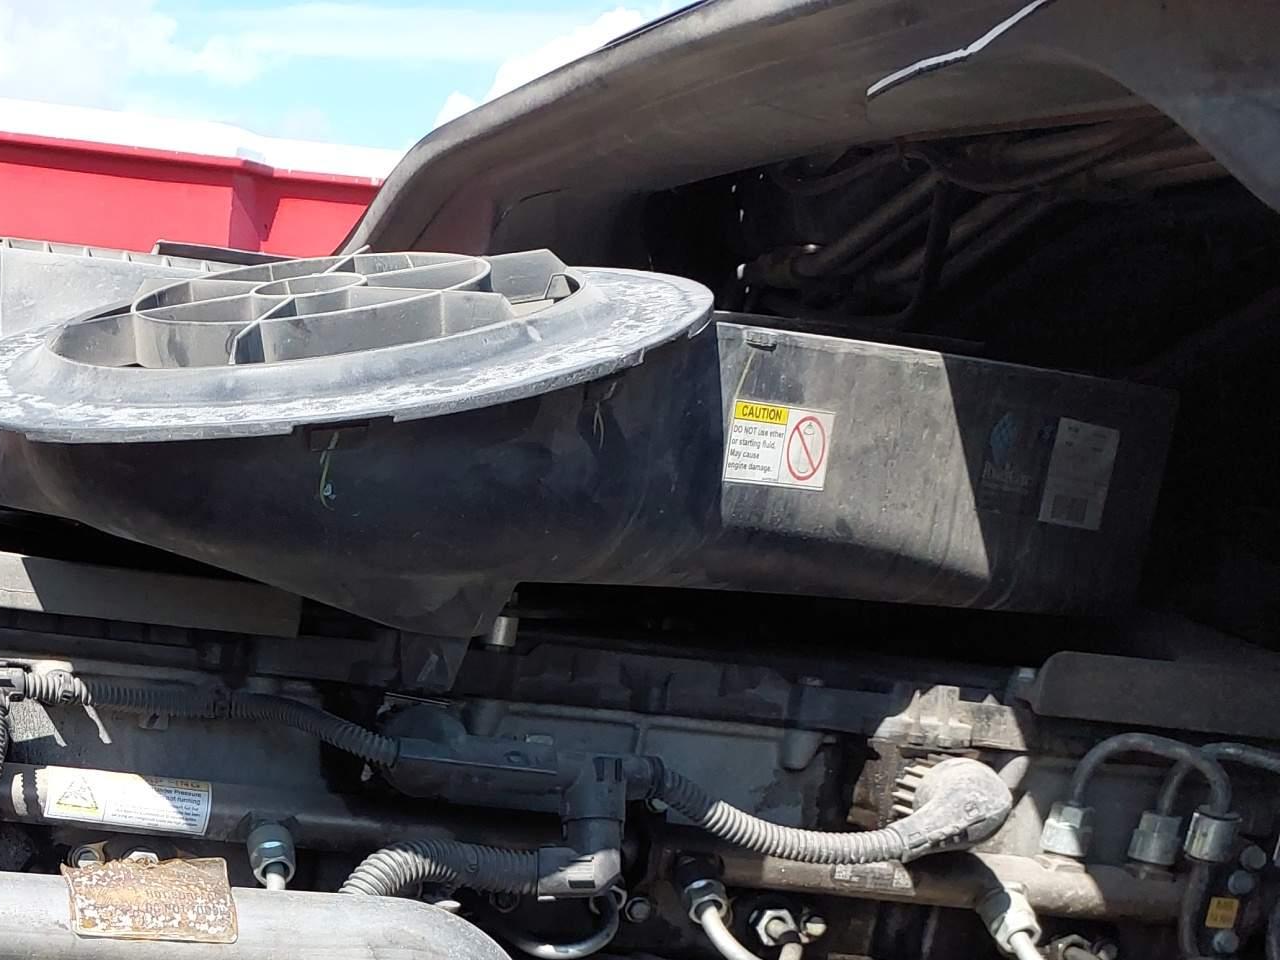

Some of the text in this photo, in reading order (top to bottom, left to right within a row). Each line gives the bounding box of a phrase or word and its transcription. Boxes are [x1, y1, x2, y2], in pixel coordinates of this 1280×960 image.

[742, 405, 782, 420] CAUTION
[733, 425, 743, 433] DO
[744, 427, 757, 435] NOT
[770, 430, 784, 438] ether
[740, 439, 761, 449] starting
[729, 449, 759, 459] May cause
[728, 462, 747, 471] engine
[173, 788, 202, 798] Pressure
[177, 797, 201, 806] running
